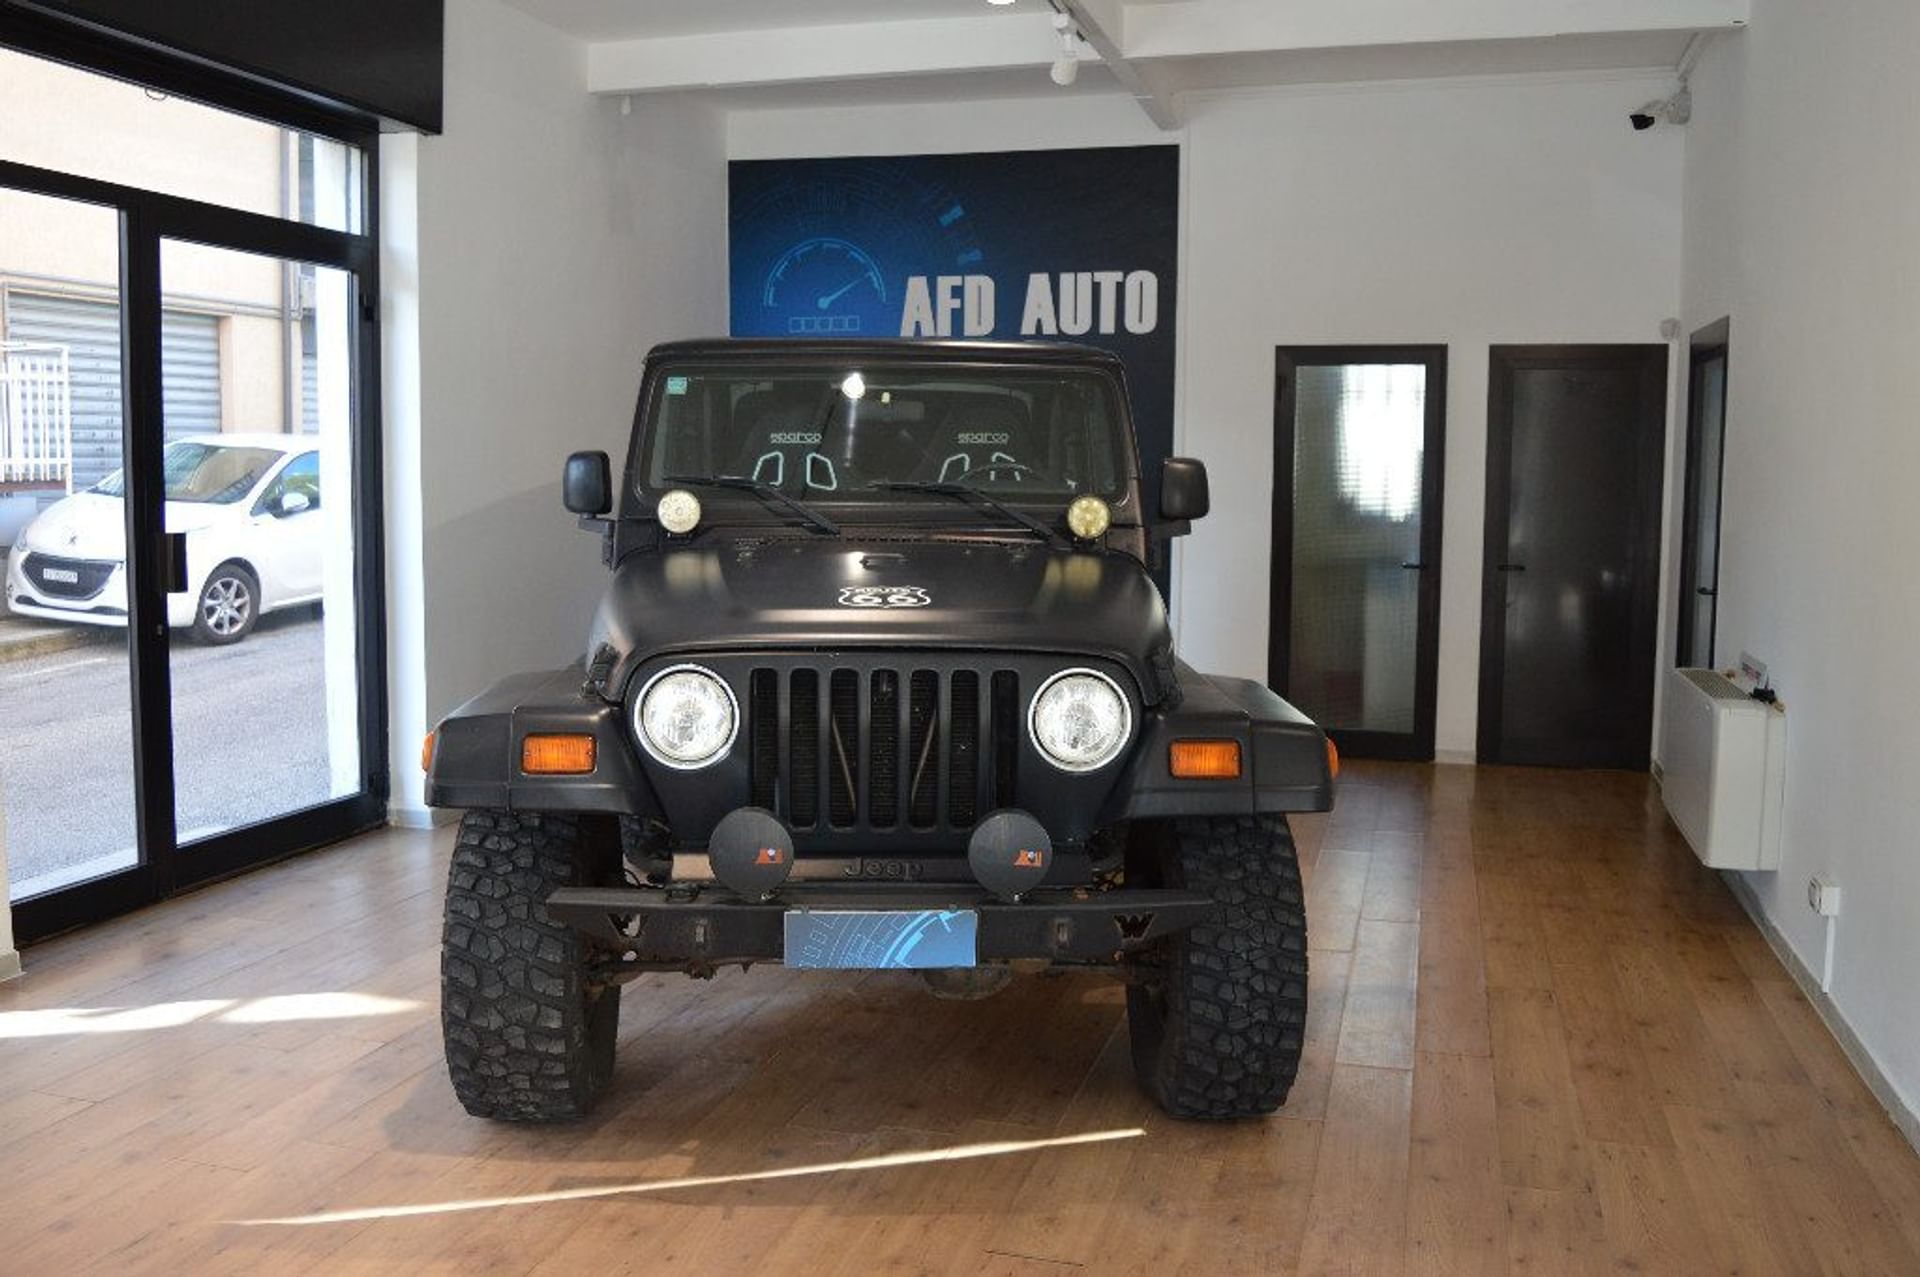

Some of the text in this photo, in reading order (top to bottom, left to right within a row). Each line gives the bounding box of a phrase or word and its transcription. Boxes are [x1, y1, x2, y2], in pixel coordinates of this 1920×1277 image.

[901, 270, 1159, 337] AFD AUTO
[841, 857, 924, 881] Jeep
